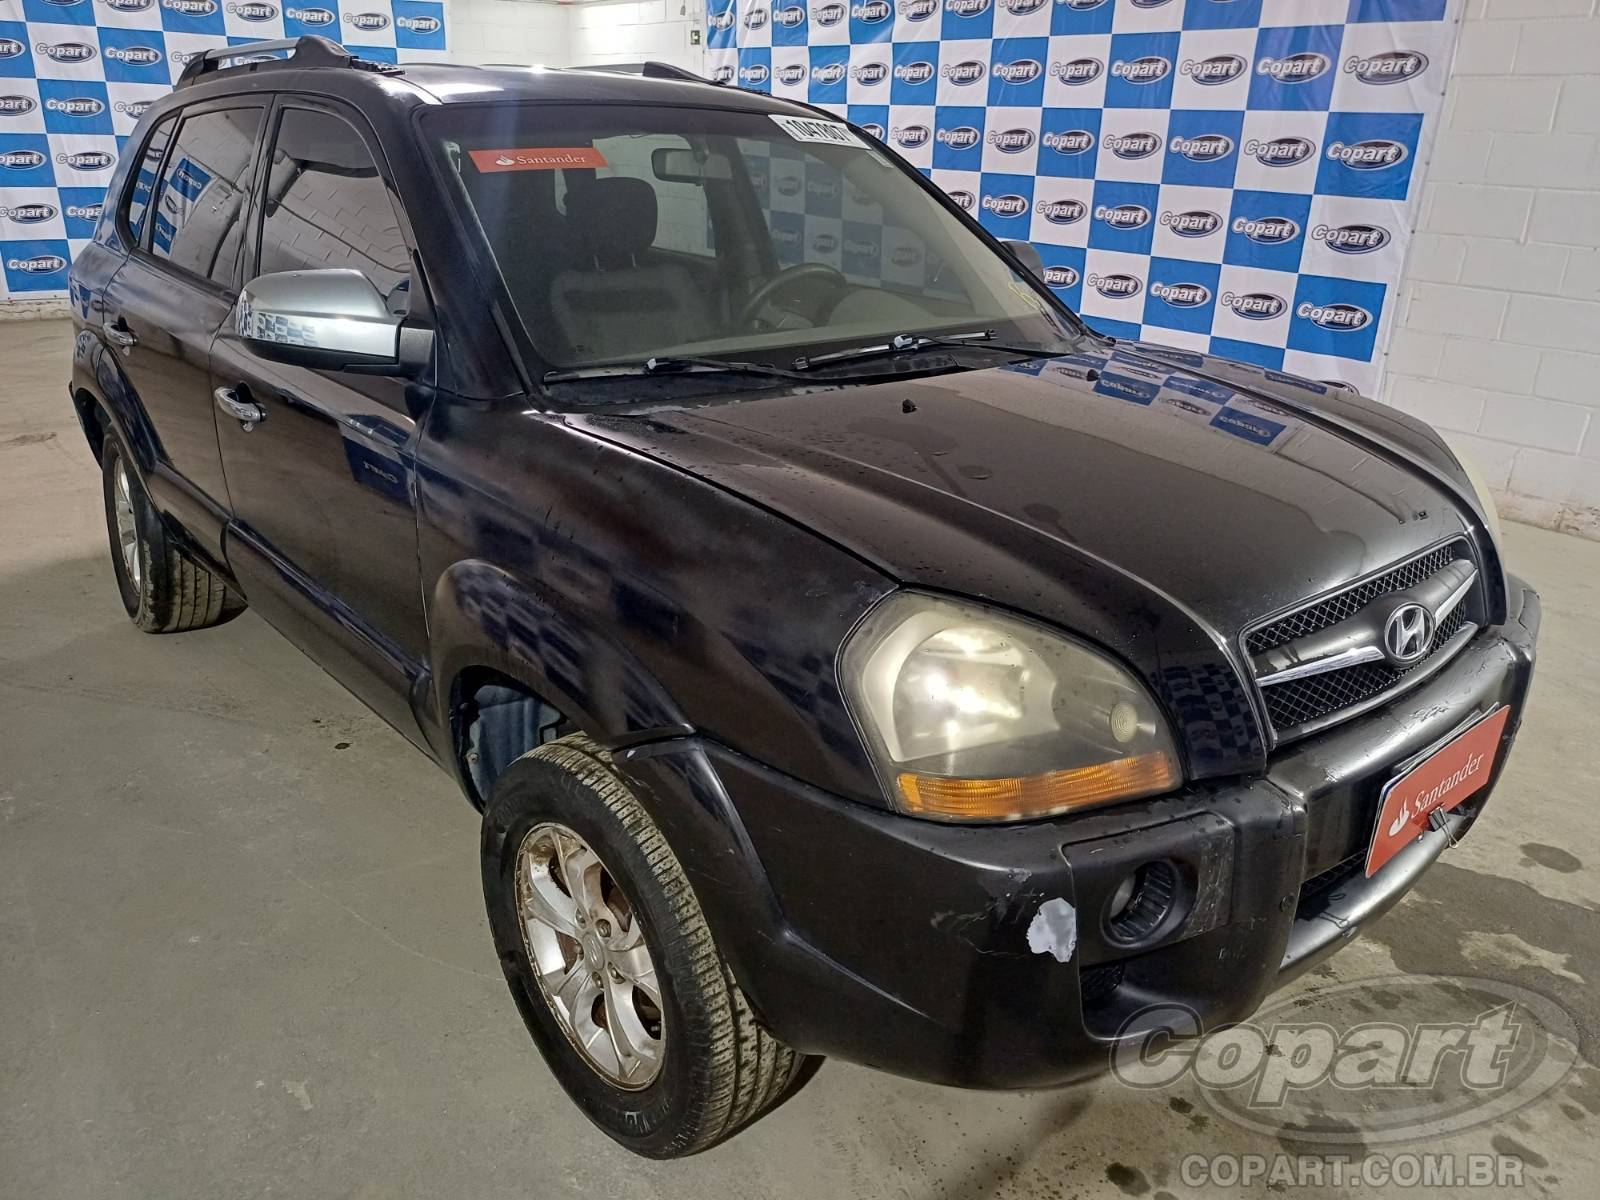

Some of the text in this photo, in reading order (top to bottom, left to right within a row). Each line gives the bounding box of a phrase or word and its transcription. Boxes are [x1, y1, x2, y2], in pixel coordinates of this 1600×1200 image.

[228, 3, 271, 18] Copart
[286, 8, 329, 23] Copart
[811, 8, 842, 23] Copart
[852, 5, 886, 20] Copart
[900, 2, 933, 17] Copart
[343, 12, 385, 28] Copart
[396, 16, 435, 31] Copart
[773, 11, 801, 26] Copart
[36, 43, 88, 58] Copart
[105, 47, 157, 62] Copart
[775, 66, 803, 81] Copart
[851, 65, 886, 80] Copart
[894, 64, 930, 79] Copart
[941, 63, 981, 80] Copart
[993, 62, 1035, 79] Copart
[1050, 61, 1097, 80] Copart
[1111, 59, 1165, 79] Copart
[1180, 59, 1240, 79] Copart
[1256, 57, 1322, 79] Copart
[1343, 55, 1418, 79] Copart
[46, 99, 98, 115] Copart
[892, 127, 926, 143] Copart
[937, 130, 974, 146] Copart
[986, 130, 1030, 148] Copart
[1042, 132, 1088, 150] Copart
[1103, 135, 1155, 152] Copart
[1170, 136, 1225, 157] Copart
[1244, 139, 1306, 160] Copart
[1326, 142, 1399, 165] Copart
[57, 153, 110, 168] Copart
[516, 154, 585, 165] Santander
[982, 196, 1023, 214] Copart
[1036, 201, 1081, 219] Copart
[1095, 207, 1145, 226] Copart
[1160, 211, 1215, 232] Copart
[1232, 217, 1294, 240] Copart
[1311, 225, 1381, 247] Copart
[9, 259, 60, 273] Copart
[1087, 274, 1136, 293] Copart
[1150, 283, 1208, 303] Copart
[1221, 292, 1281, 314] Copart
[1296, 302, 1365, 326] Copart
[1411, 752, 1483, 820] Santander
